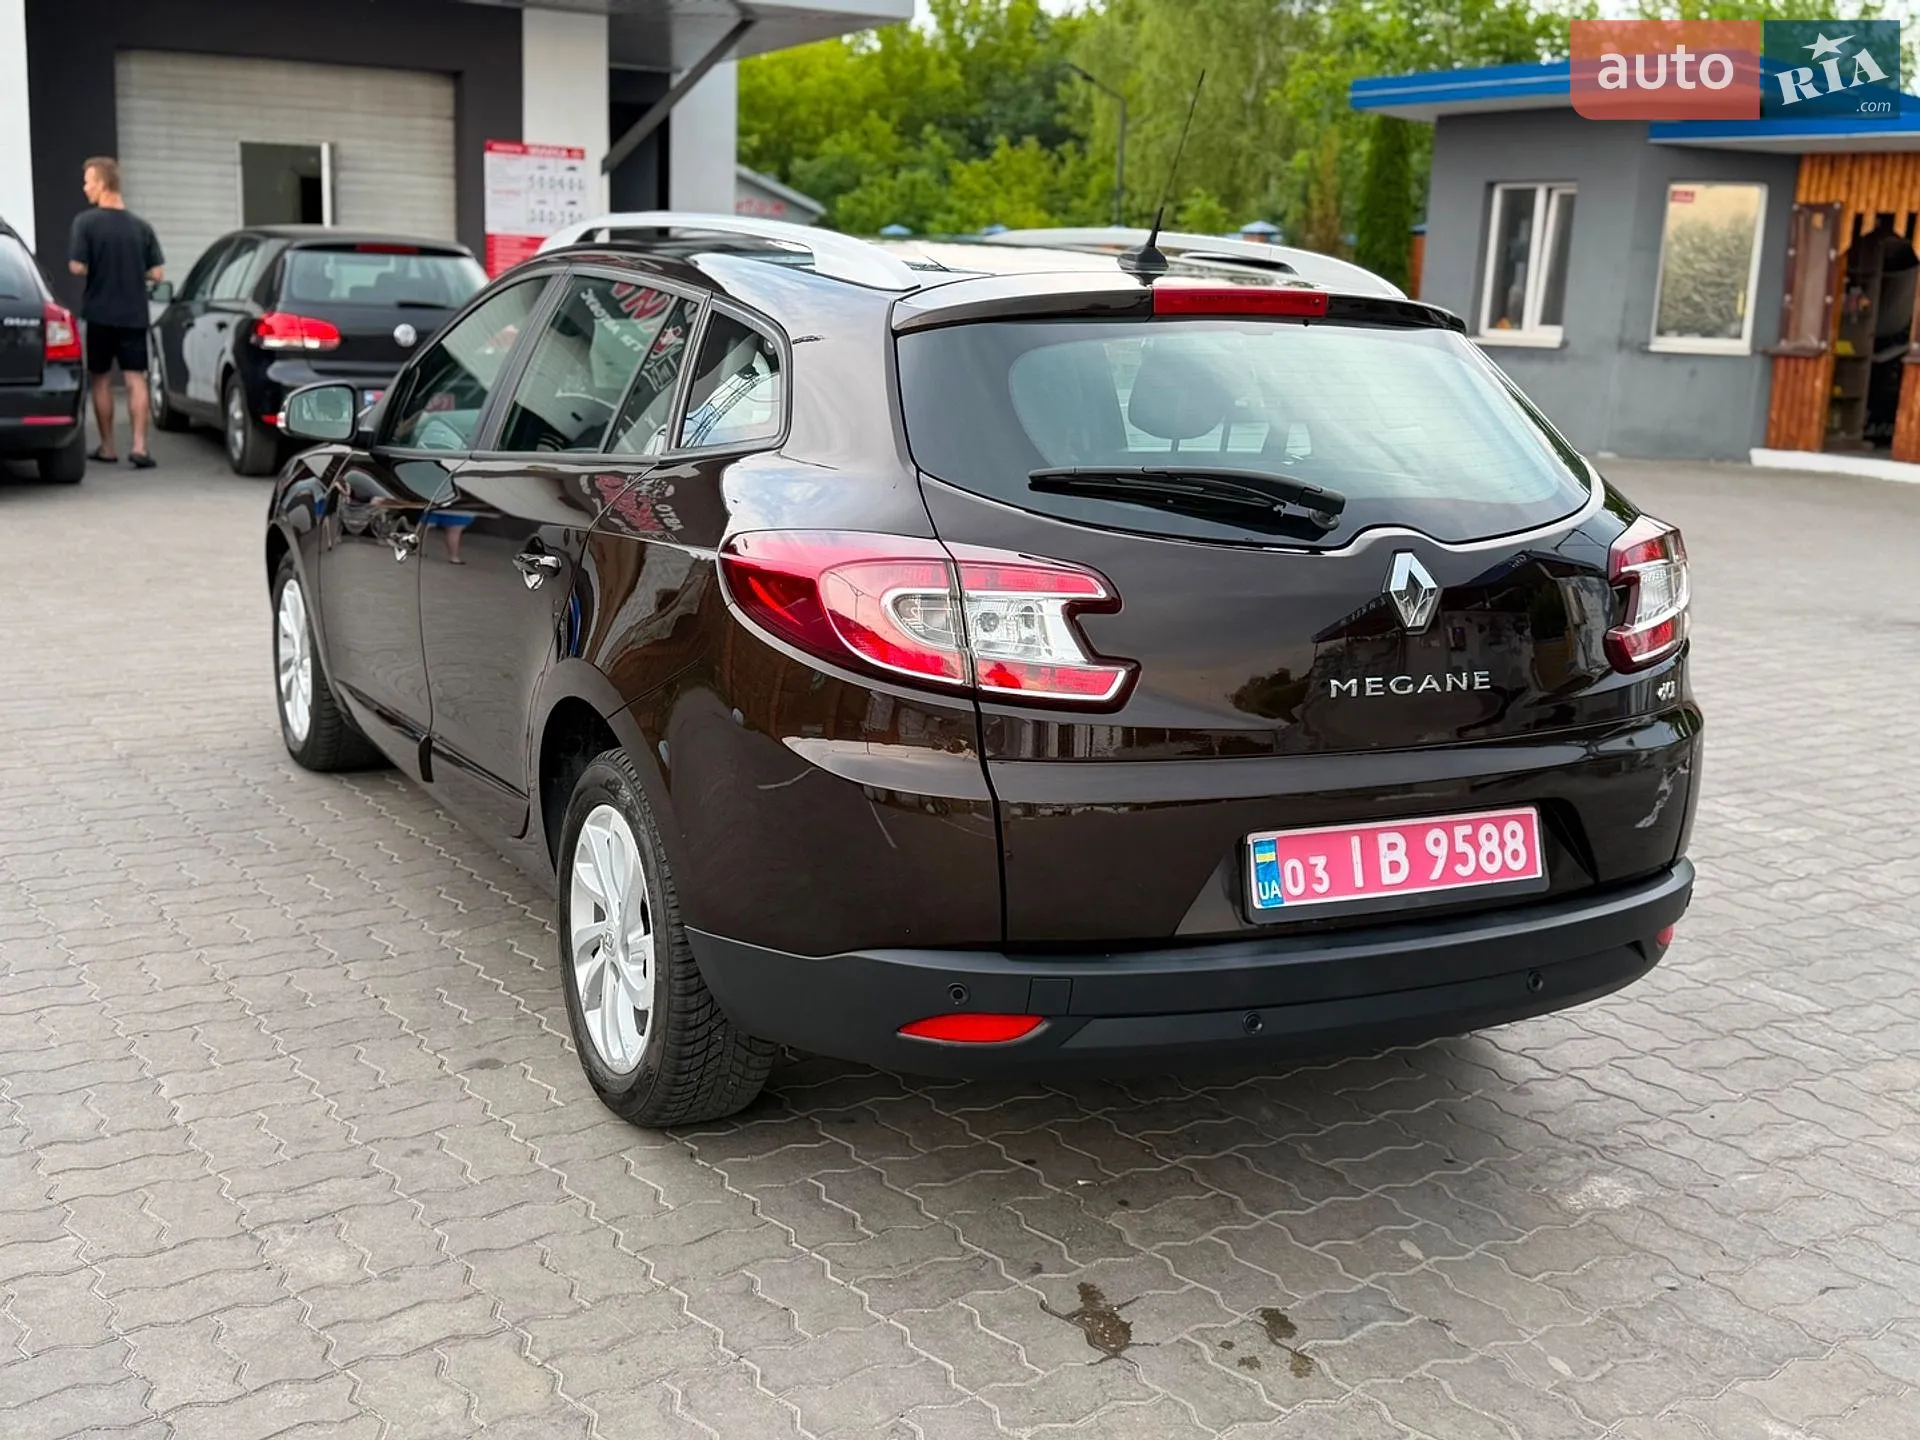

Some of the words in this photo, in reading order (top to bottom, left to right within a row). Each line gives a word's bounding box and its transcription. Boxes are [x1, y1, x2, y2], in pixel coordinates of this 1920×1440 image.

[1329, 671, 1491, 699] MEGANE
[1283, 855, 1331, 896] 03
[1425, 820, 1527, 880] 9588
[1258, 881, 1281, 900] UA
